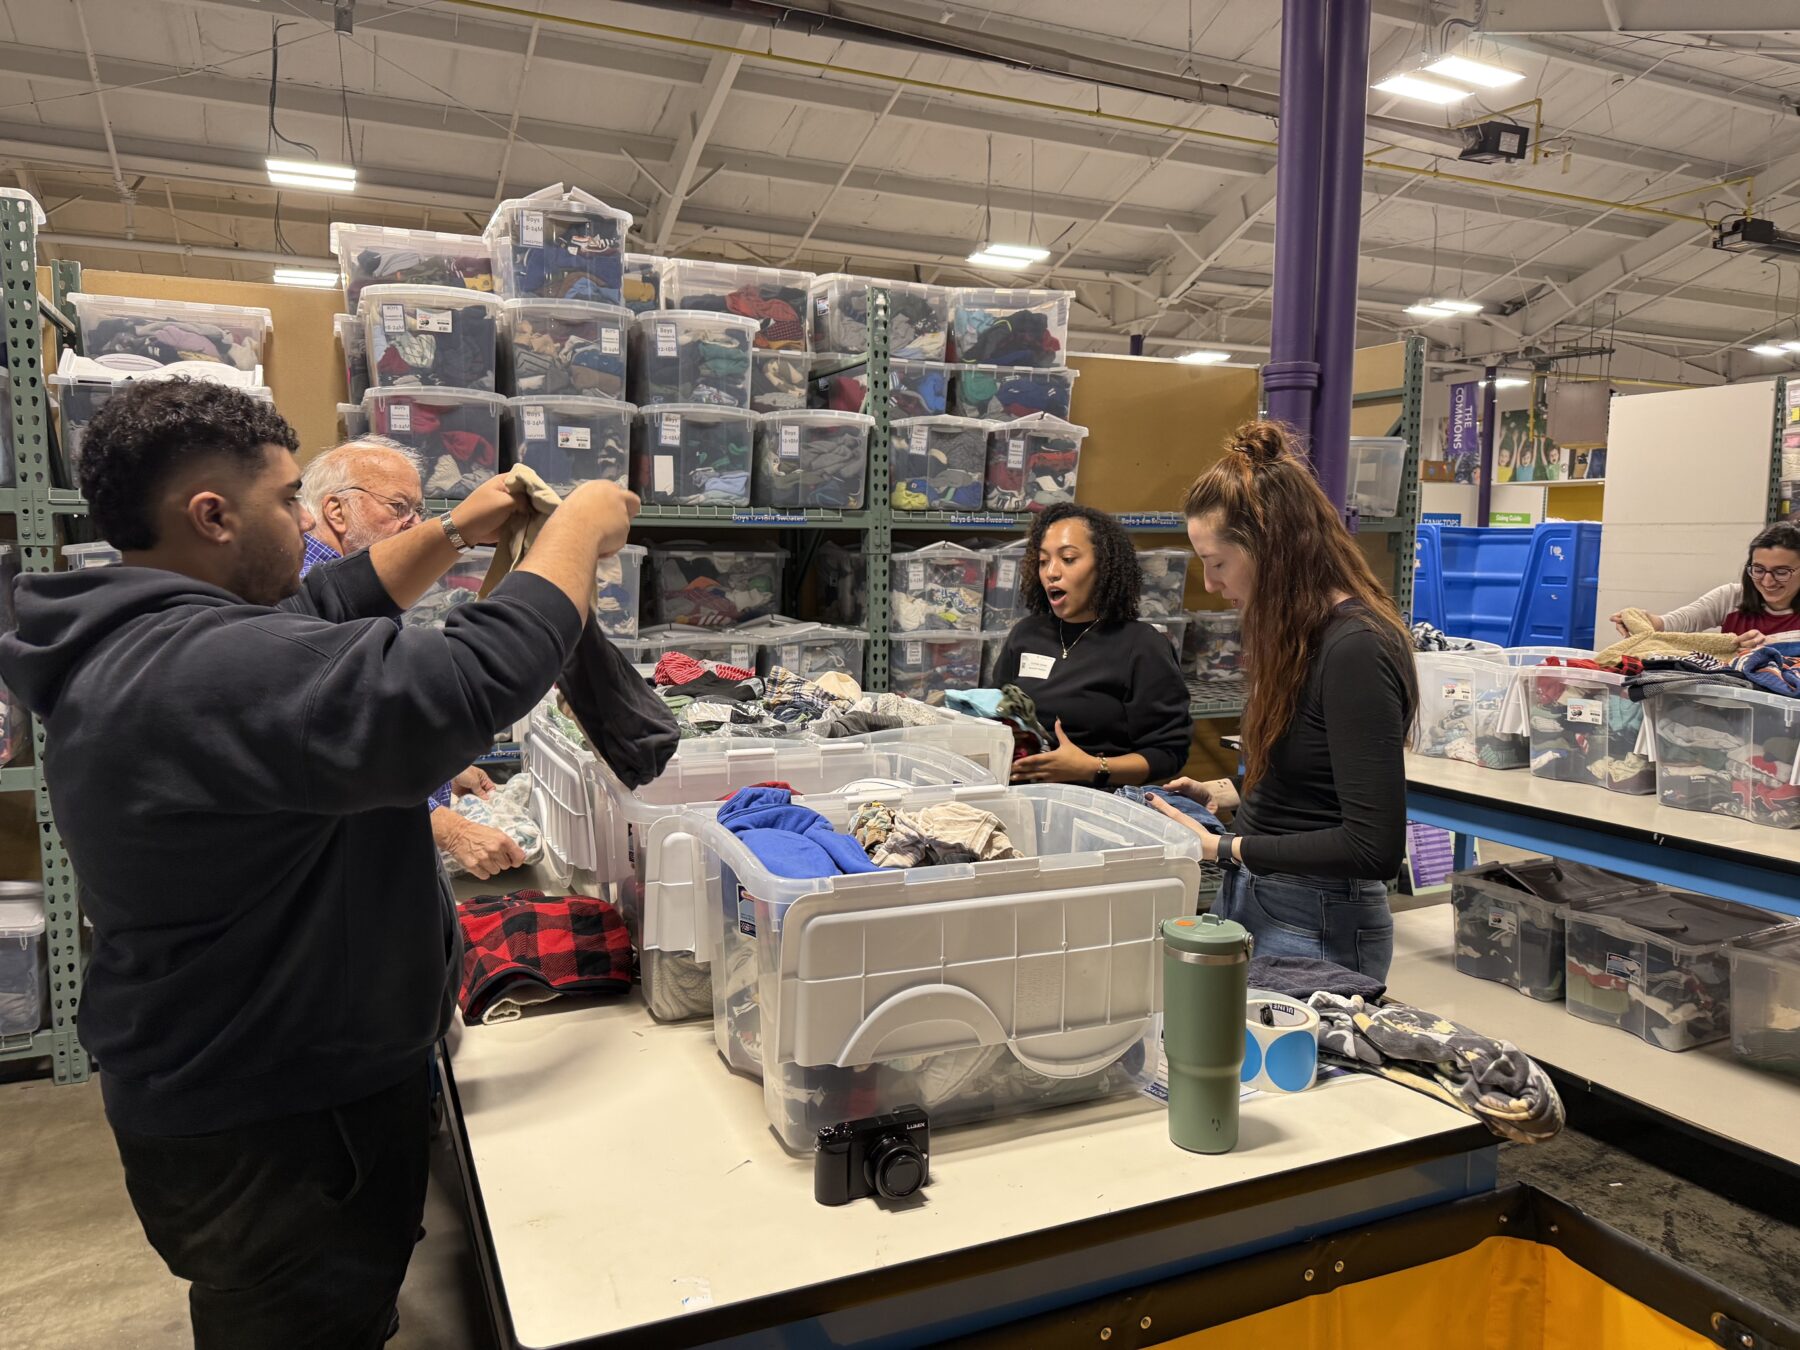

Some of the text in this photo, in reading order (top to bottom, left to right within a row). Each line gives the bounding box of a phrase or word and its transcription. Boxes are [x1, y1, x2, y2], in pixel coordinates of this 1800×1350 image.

[1453, 387, 1464, 449] COMMONS
[1464, 405, 1473, 429] THE
[1495, 514, 1508, 522] Sizing
[1441, 519, 1459, 527] TOPS
[1273, 1004, 1293, 1014] ULINE
[906, 1122, 926, 1130] LUMIX
